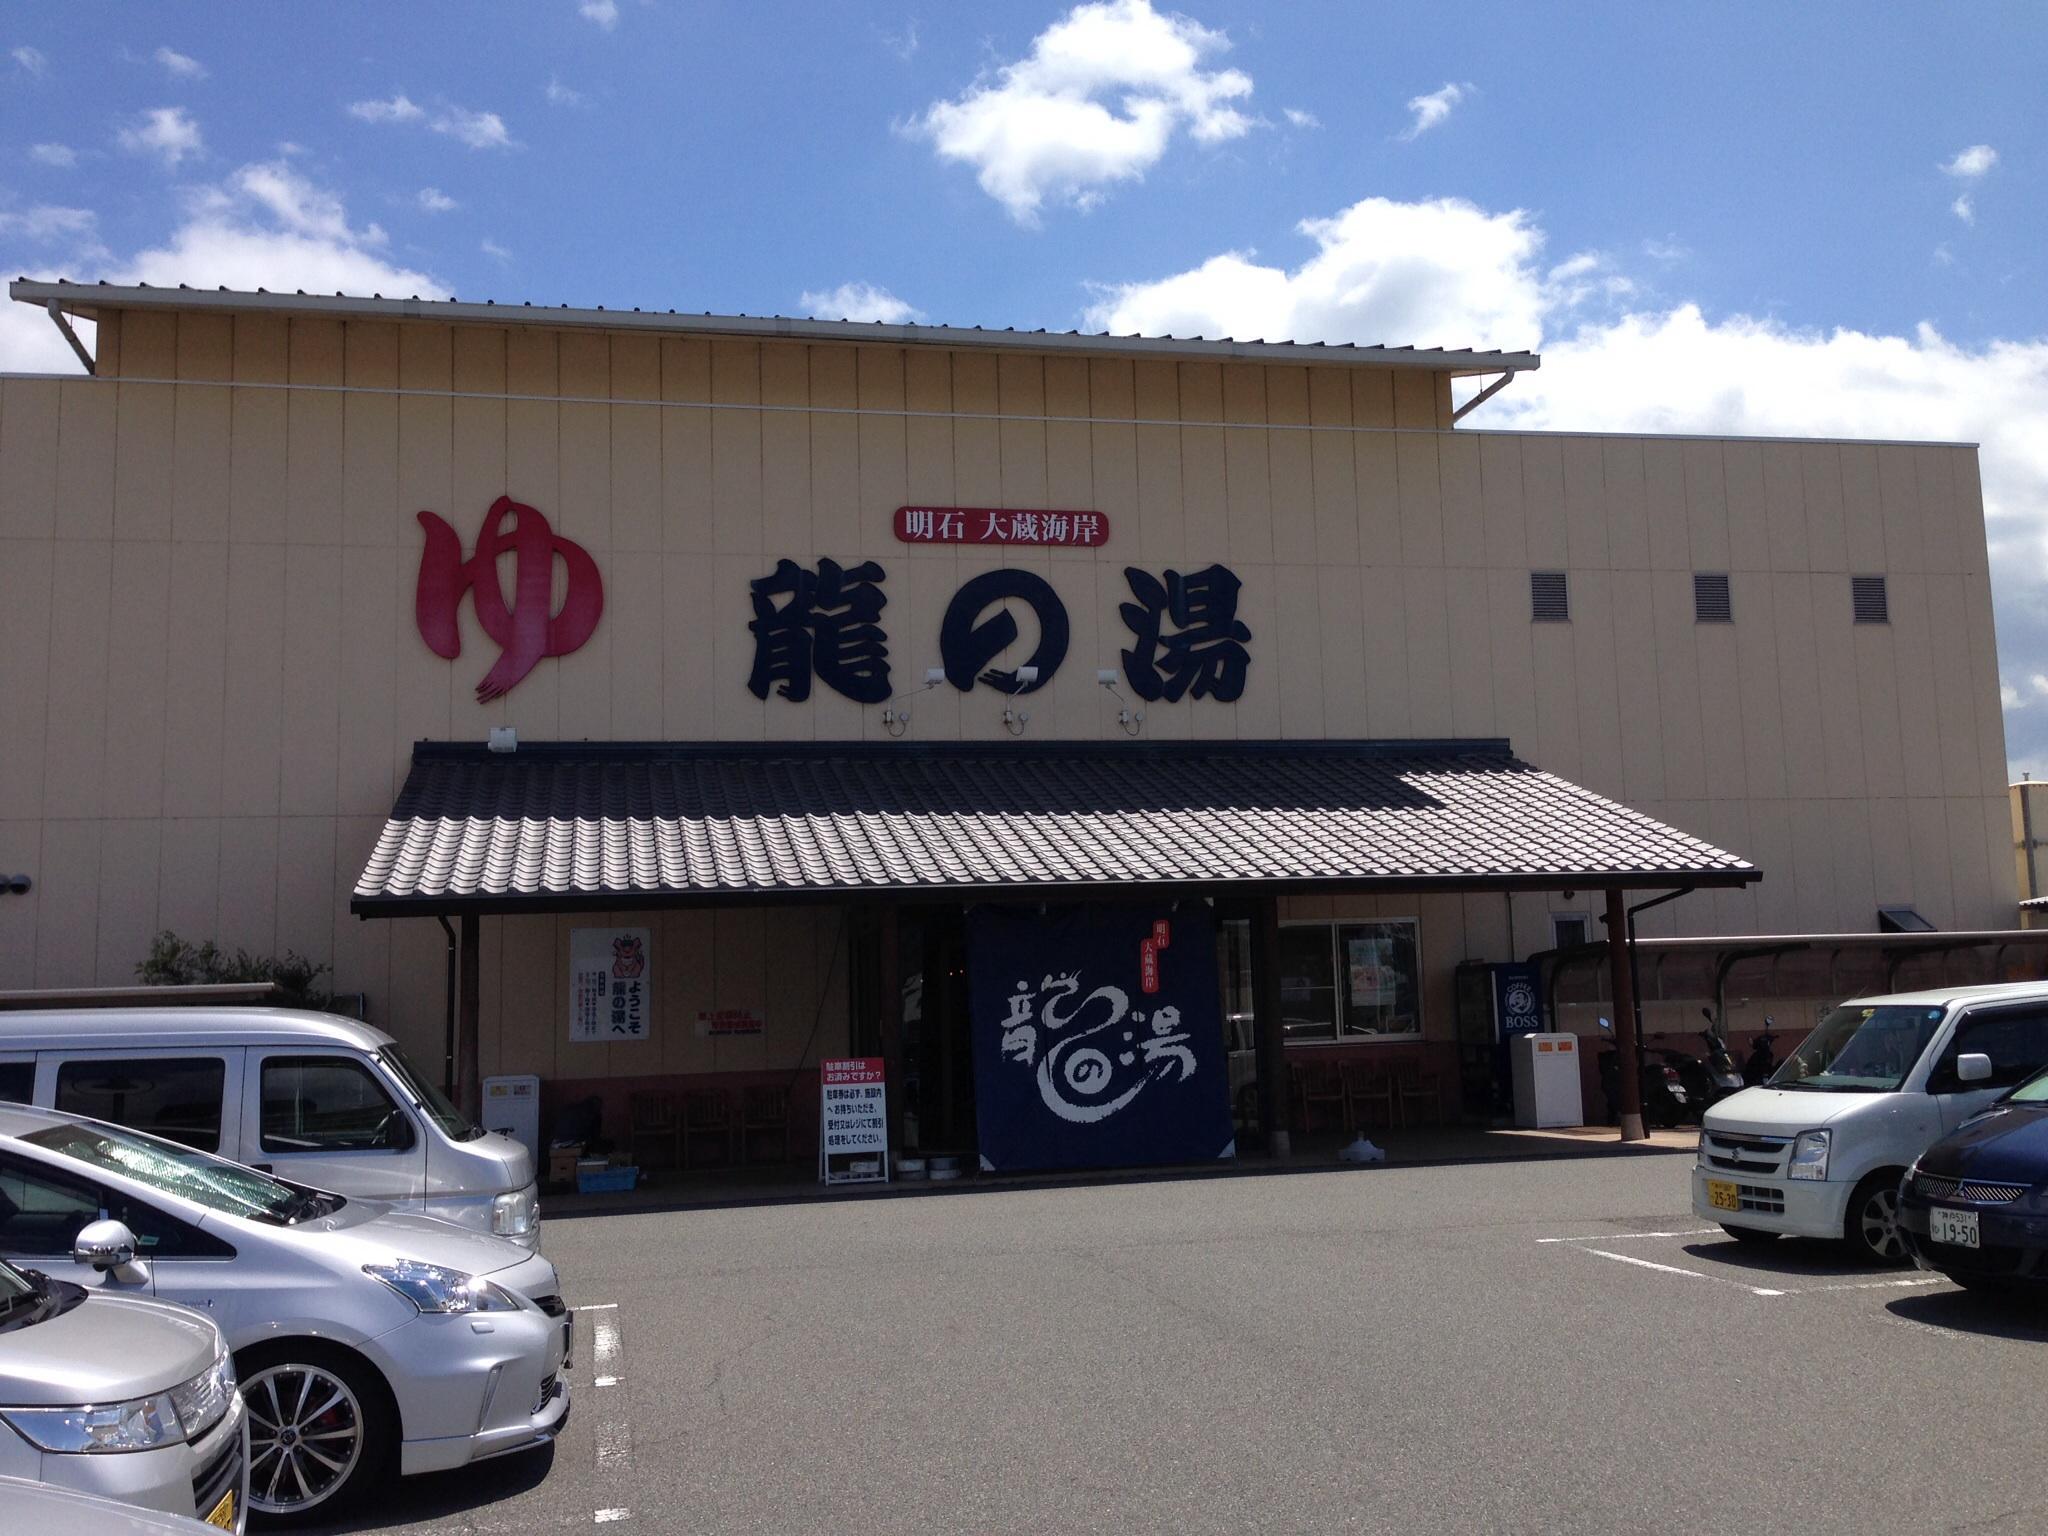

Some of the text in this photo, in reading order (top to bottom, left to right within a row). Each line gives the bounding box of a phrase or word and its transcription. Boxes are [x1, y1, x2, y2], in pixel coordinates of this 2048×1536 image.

[905, 510, 1100, 543] 明石 大蔵海岸
[416, 494, 604, 706] ゆ
[747, 556, 1254, 706] 龍の湯
[1156, 922, 1166, 947] 明石
[611, 981, 626, 1034] 龍の湯へ
[628, 981, 642, 1034] ようこそ
[1505, 1016, 1538, 1028] BOSS
